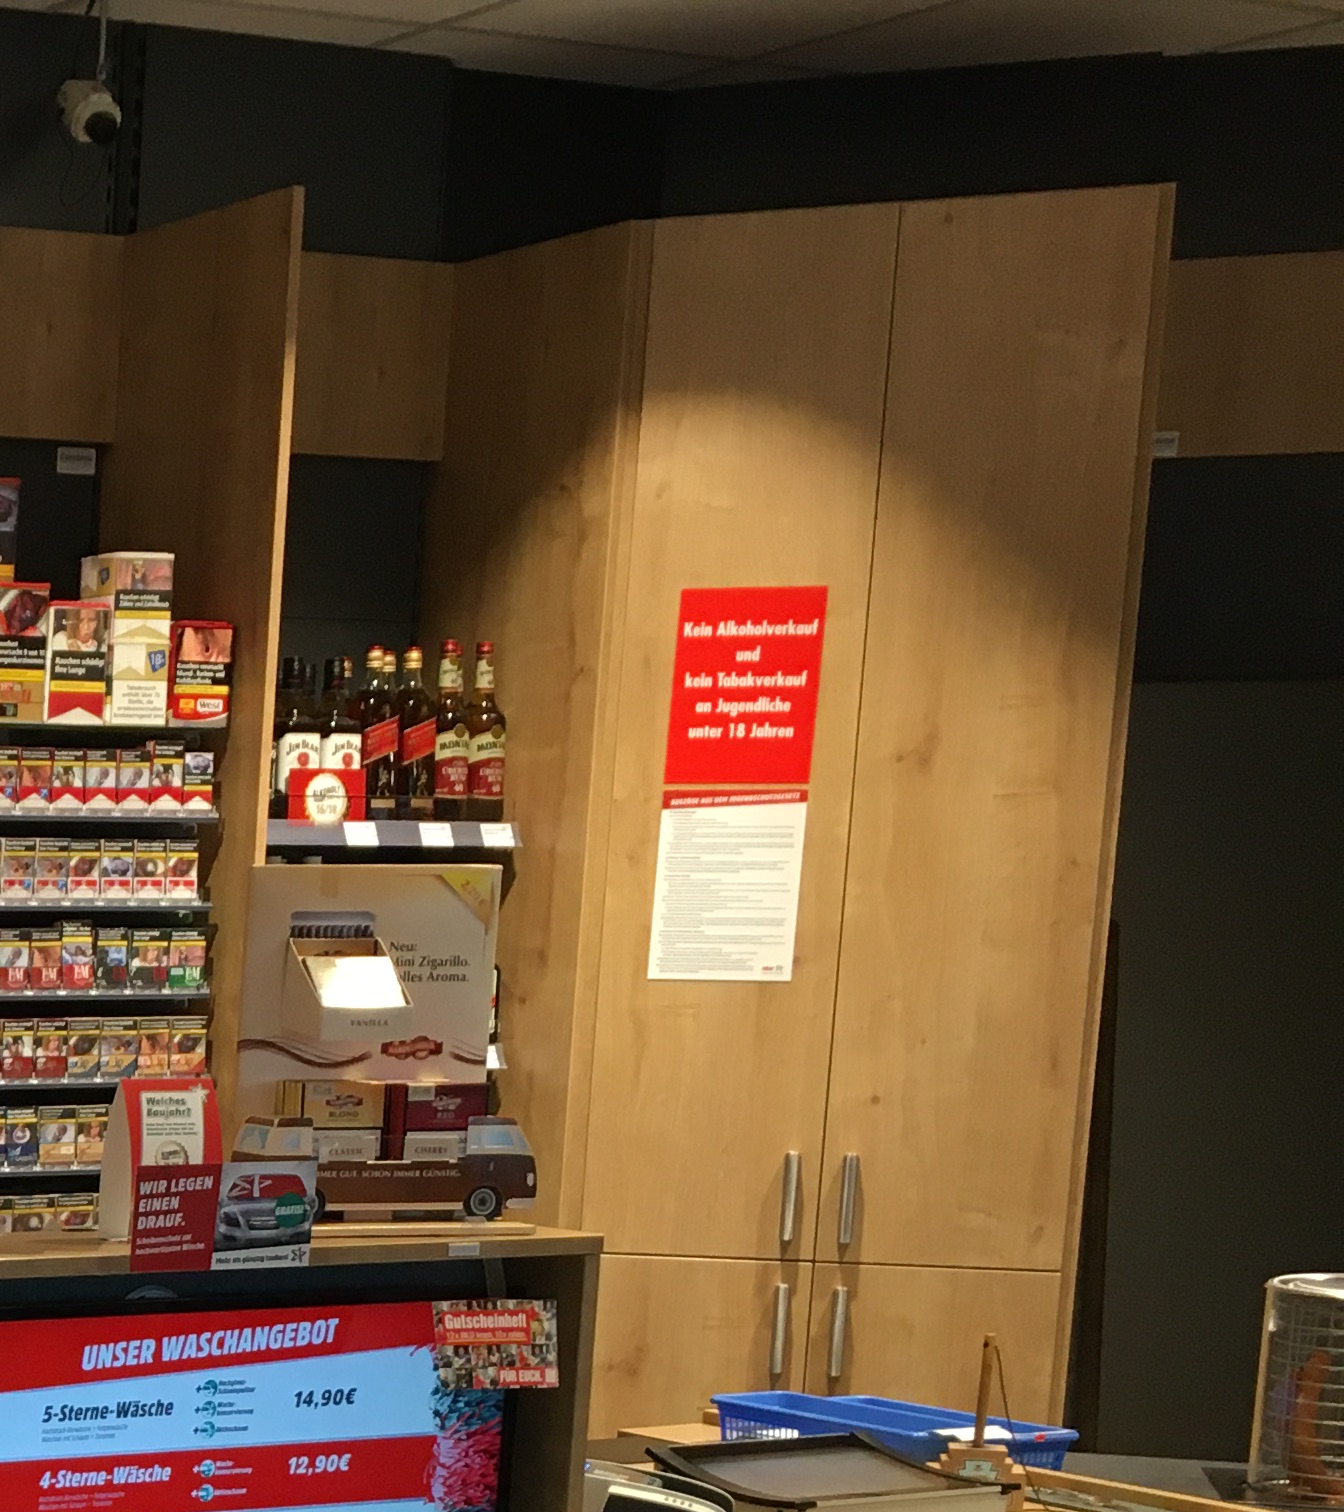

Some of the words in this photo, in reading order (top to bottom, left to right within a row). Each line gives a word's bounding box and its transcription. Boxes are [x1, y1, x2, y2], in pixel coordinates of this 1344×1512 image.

[684, 621, 712, 637] Kein
[716, 620, 819, 636] Alkoholverkauf
[736, 647, 761, 662] und
[685, 672, 713, 688] kein
[717, 671, 808, 688] Tabakverkauf
[695, 700, 712, 713] an
[716, 698, 792, 717] Jugendliche
[688, 724, 723, 739] unter
[728, 724, 745, 738] 18
[750, 723, 794, 739] Jahren
[390, 941, 417, 952] Neu:
[419, 955, 470, 970] Zigarillo.
[427, 972, 469, 982] Aroma.
[146, 1096, 186, 1106] Welches
[146, 1107, 192, 1119] Baujahr?
[139, 1179, 167, 1196] WIR
[171, 1175, 214, 1192] LEGEN
[139, 1196, 180, 1213] EINEN
[137, 1213, 185, 1230] DRAUF.
[444, 1312, 527, 1330] Gutscheinheft
[81, 1338, 155, 1371] UNSER
[161, 1318, 339, 1363] WASCHANGEBOT
[42, 1399, 174, 1424] 5-Sterne-Wäsche
[293, 1388, 357, 1409] 14,90€
[39, 1463, 172, 1489] 4-Sterne-Wäsche
[287, 1453, 351, 1477] 12,90€
